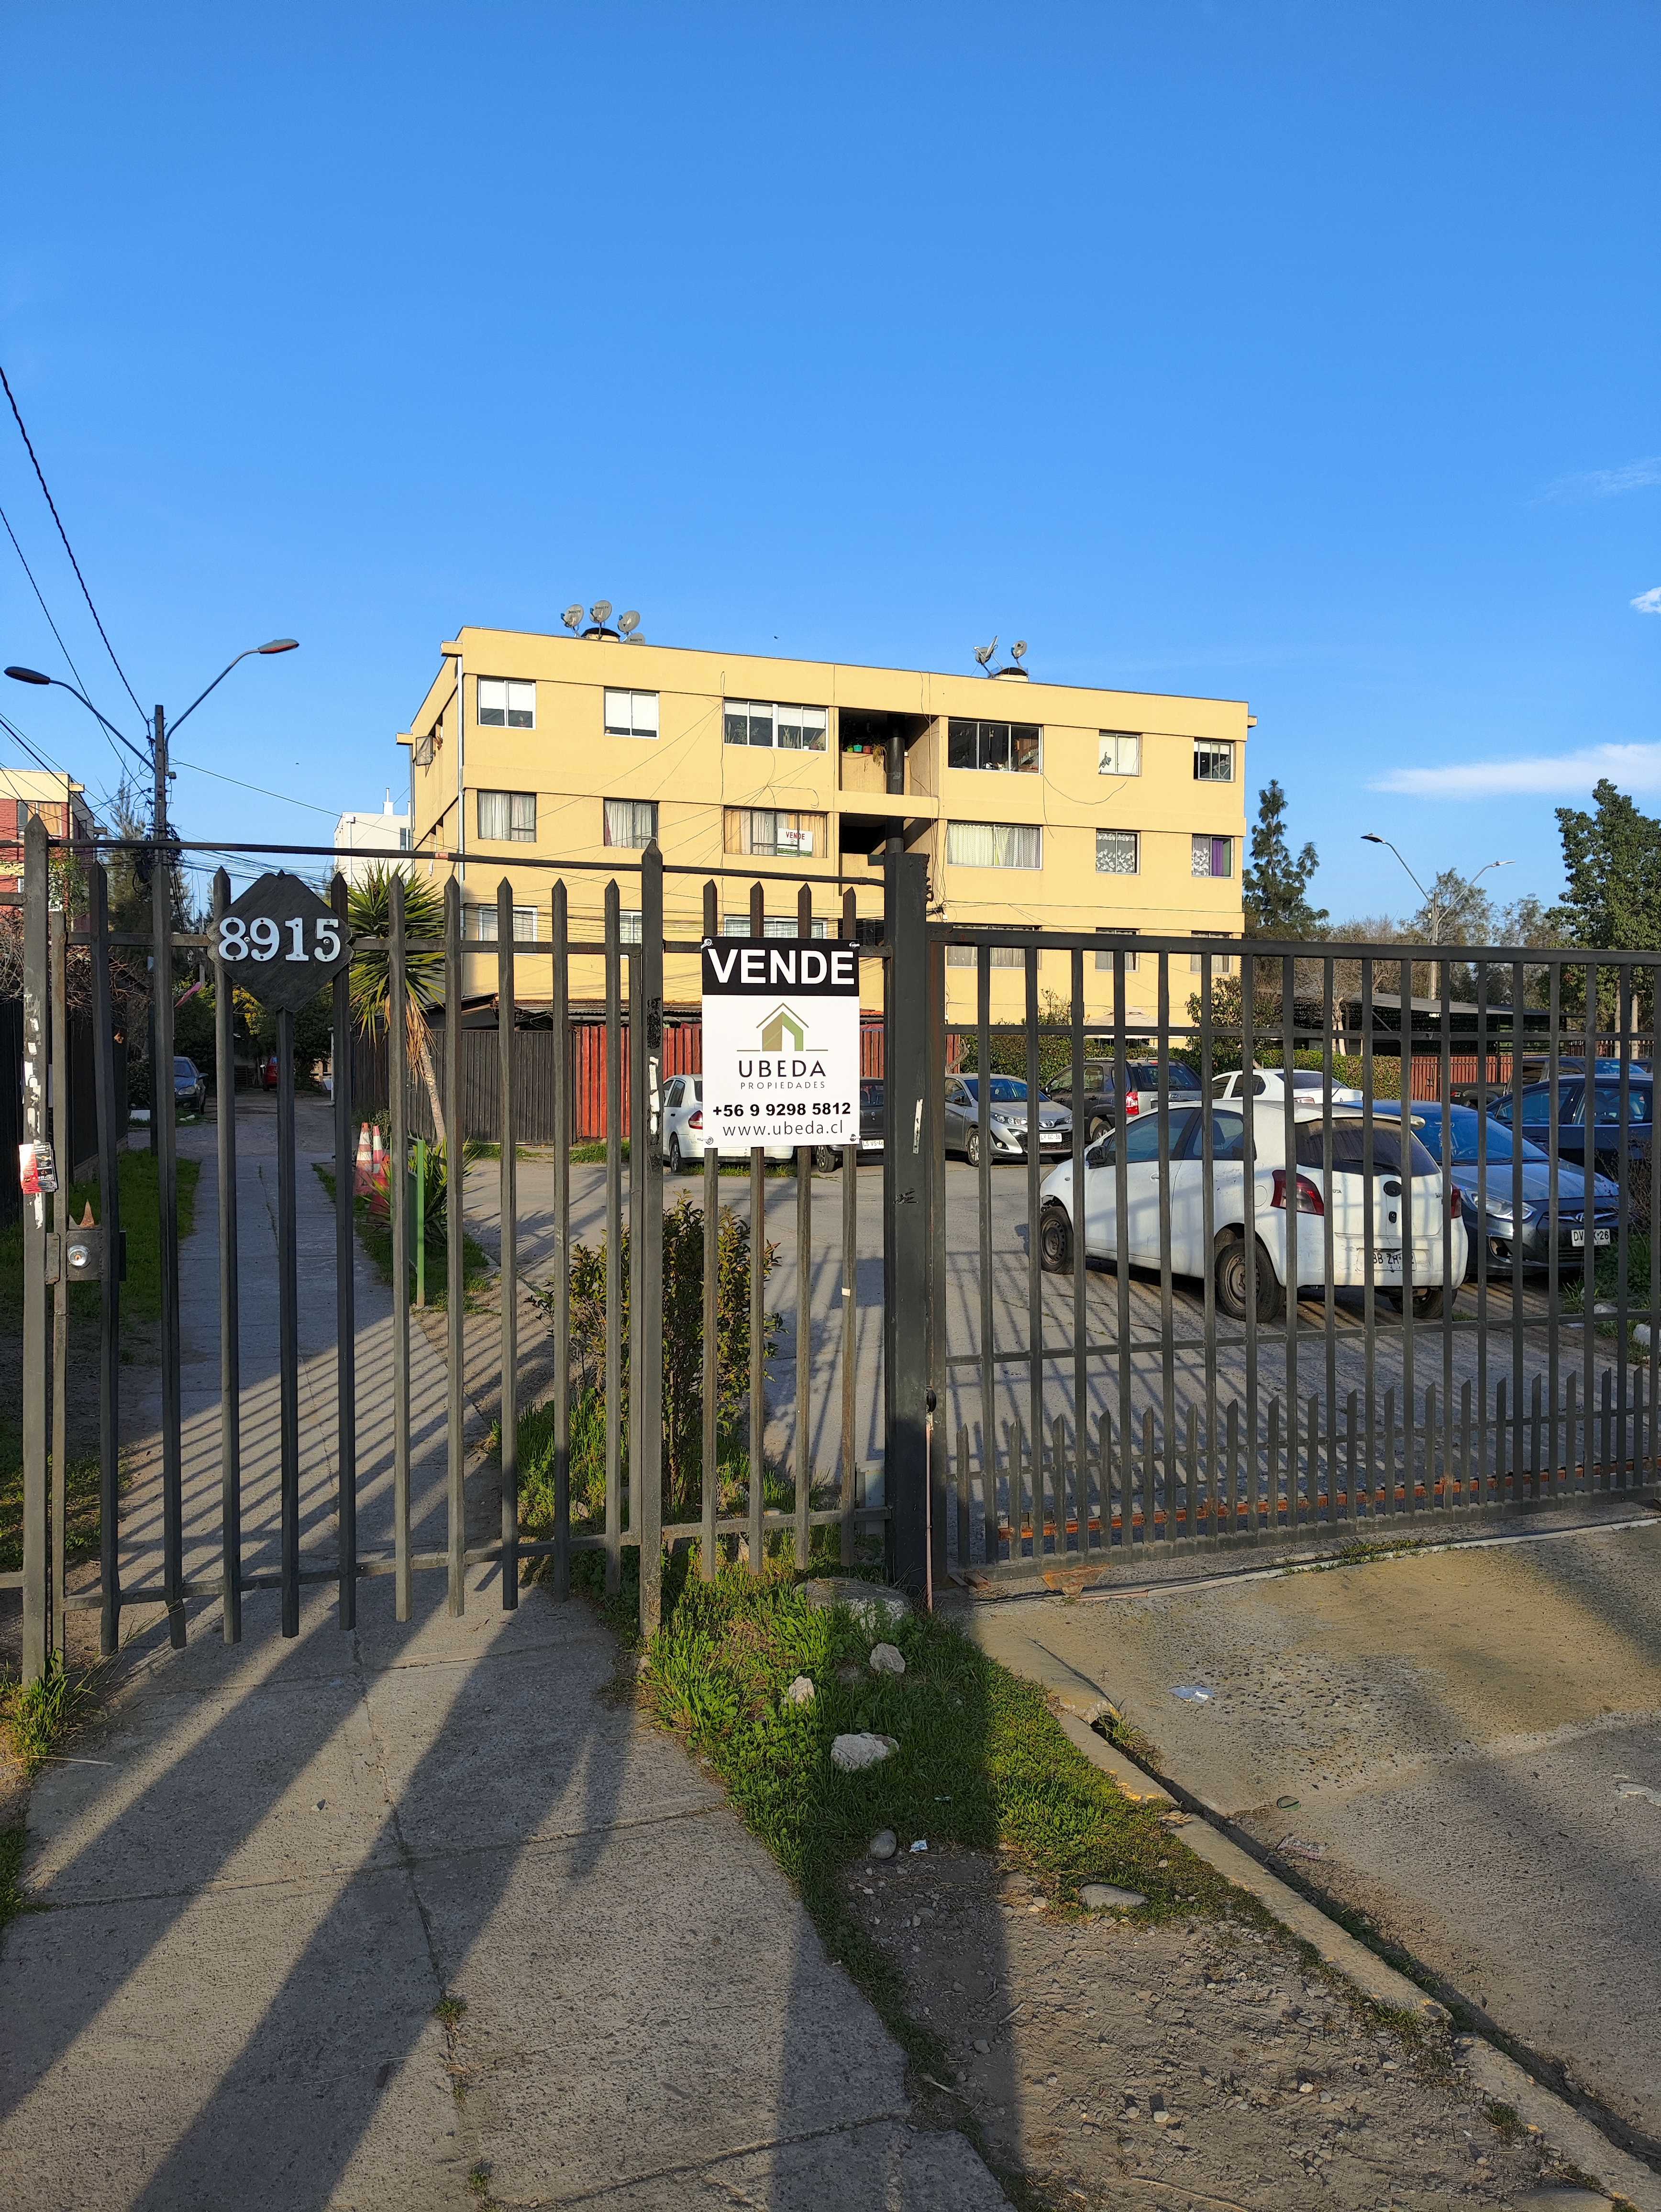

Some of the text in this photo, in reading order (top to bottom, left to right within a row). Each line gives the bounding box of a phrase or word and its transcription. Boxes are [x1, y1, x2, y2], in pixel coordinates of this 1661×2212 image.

[786, 831, 805, 840] VENDE
[218, 917, 341, 962] 8915
[707, 948, 854, 984] VENDE
[739, 1060, 826, 1078] UBEDA
[741, 1081, 825, 1090] PROPIEDADES
[713, 1102, 851, 1117] +56 9 9298 5812
[723, 1119, 842, 1136] www.ubeda.cl
